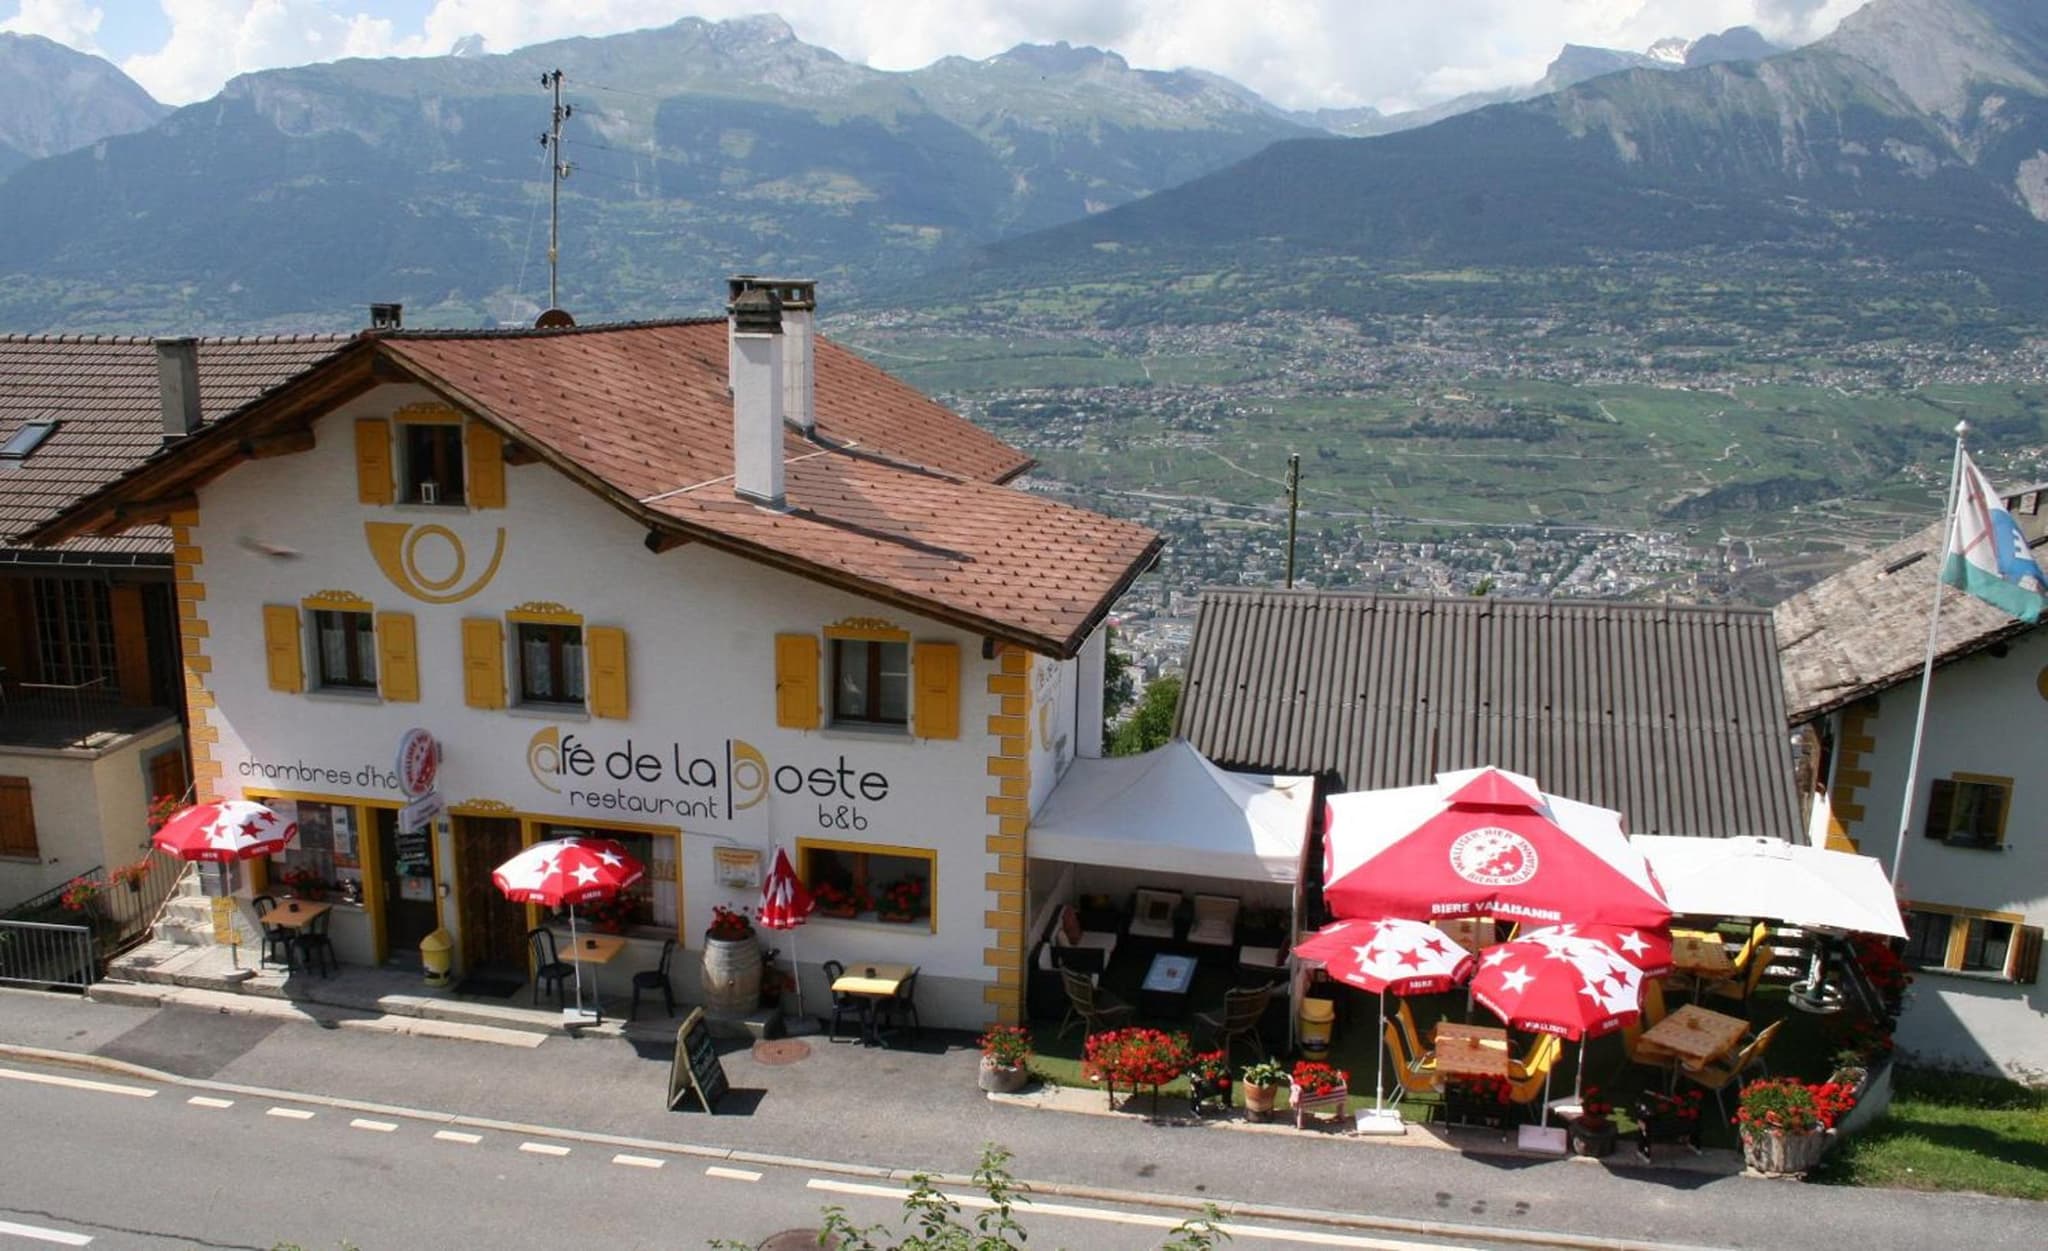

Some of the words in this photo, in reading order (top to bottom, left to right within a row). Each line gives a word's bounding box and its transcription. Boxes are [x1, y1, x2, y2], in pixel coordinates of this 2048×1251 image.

[239, 755, 352, 785] chambres
[606, 739, 662, 782] de
[674, 743, 717, 788] la
[726, 739, 888, 820] poste
[569, 788, 718, 819] restaurant
[818, 803, 868, 831] b&b
[1431, 903, 1470, 914] BIERE
[1475, 901, 1562, 920] VALAISANNE
